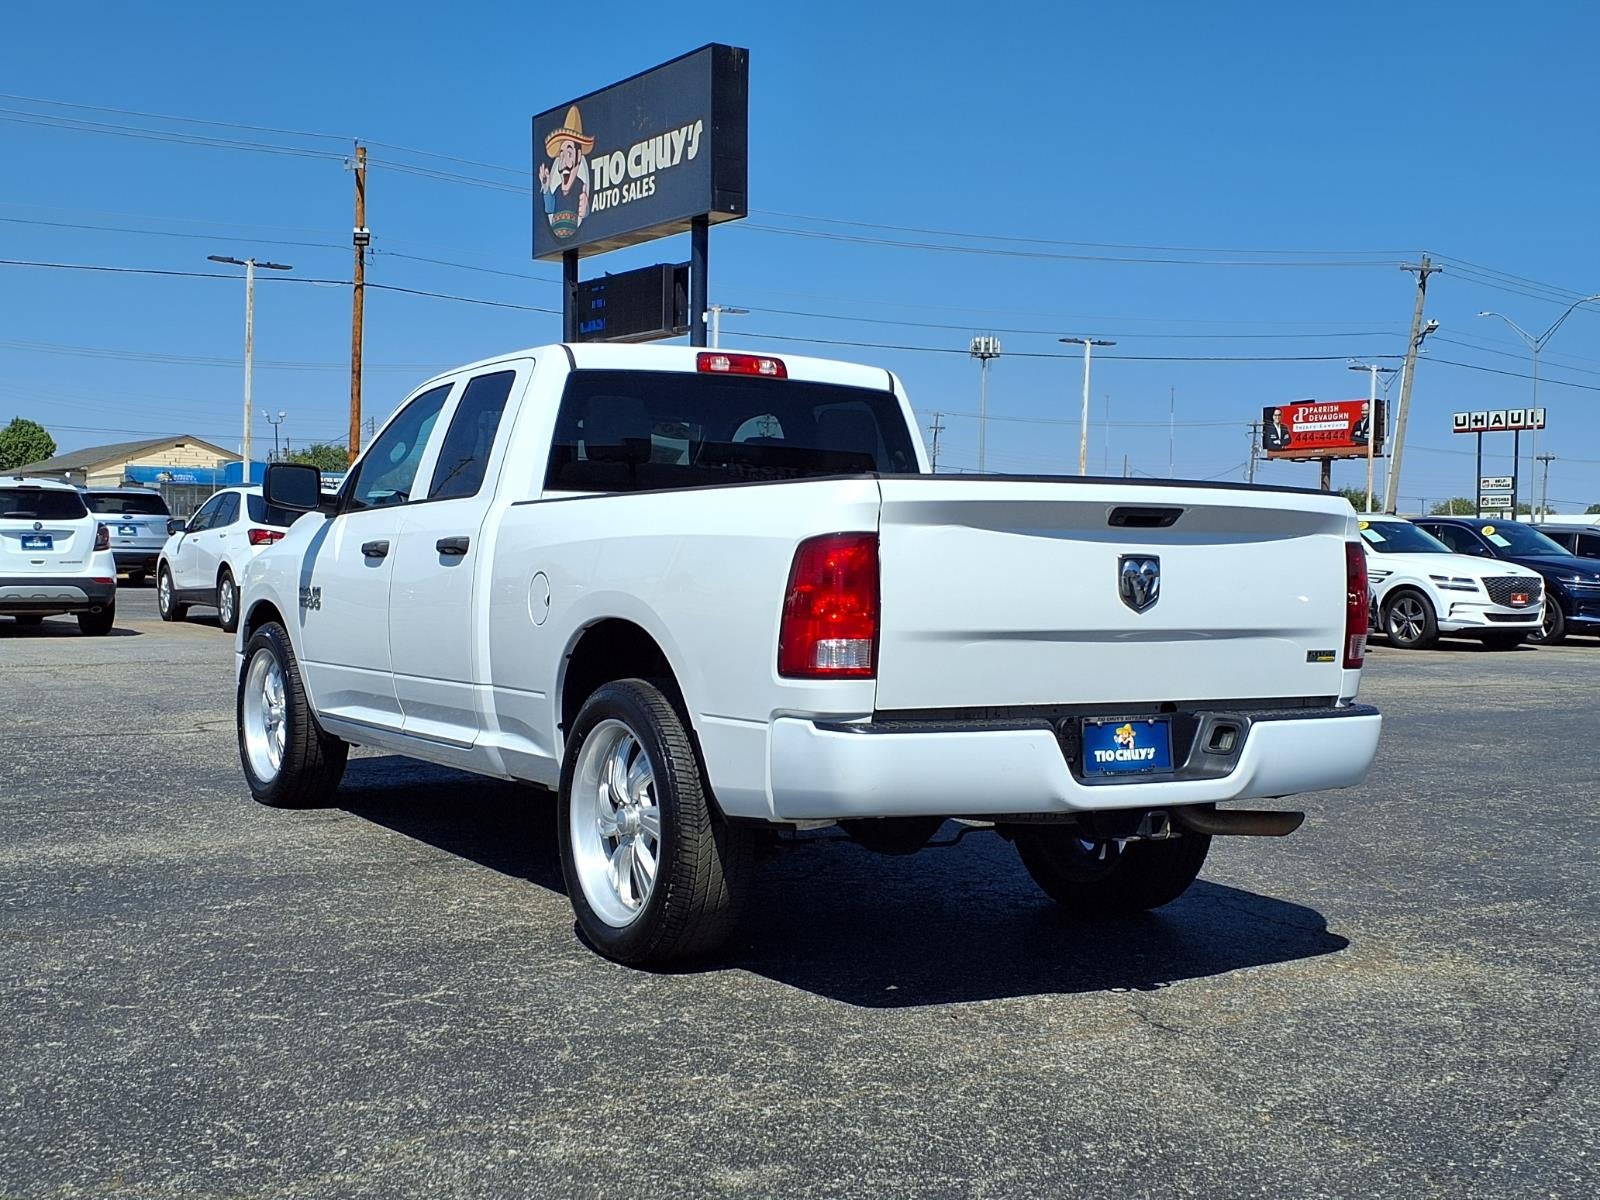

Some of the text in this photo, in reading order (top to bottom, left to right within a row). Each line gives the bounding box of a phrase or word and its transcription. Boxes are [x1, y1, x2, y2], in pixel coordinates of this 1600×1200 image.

[591, 119, 703, 190] TIO CHUY'S
[591, 175, 655, 213] AUTO SALES
[1309, 405, 1338, 413] PARRISH
[1309, 412, 1348, 421] DEVAUGHN
[1094, 747, 1156, 762] TIO CHUY'S
